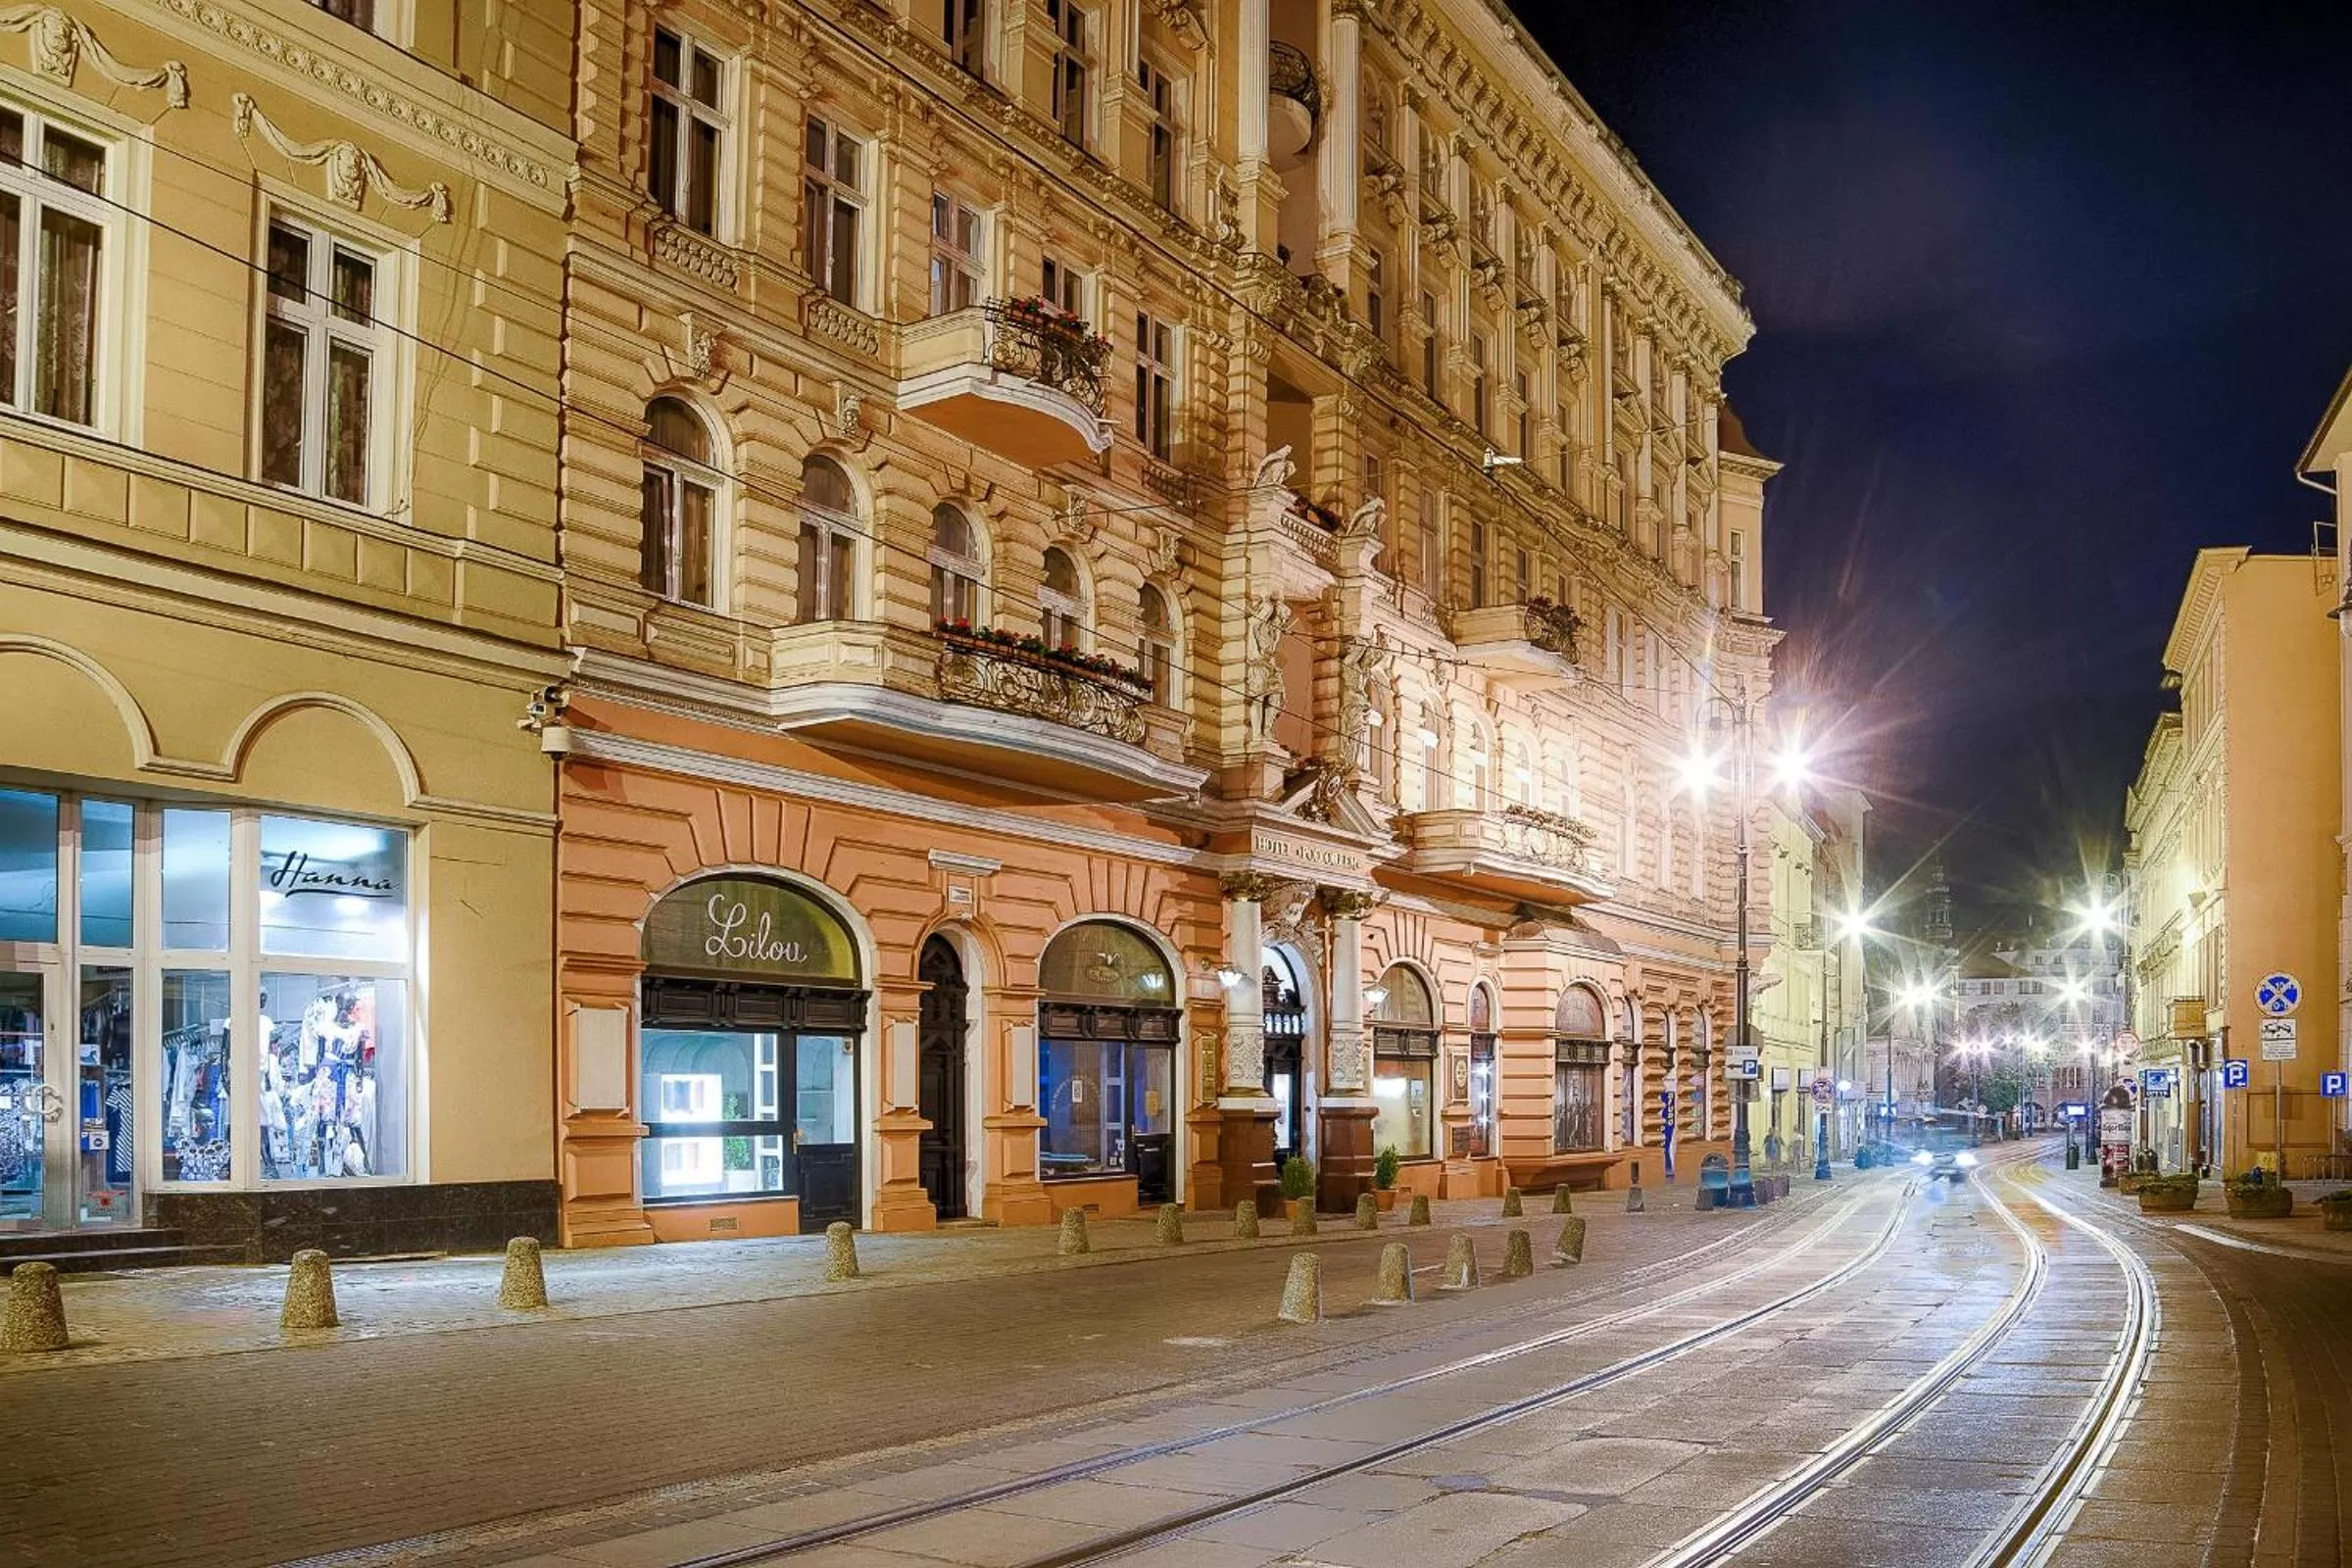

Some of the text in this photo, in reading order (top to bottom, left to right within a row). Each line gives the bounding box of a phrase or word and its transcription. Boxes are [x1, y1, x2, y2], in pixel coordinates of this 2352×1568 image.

[270, 851, 400, 891] Hanna
[706, 893, 808, 963] Lilou
[2326, 1075, 2342, 1094] P
